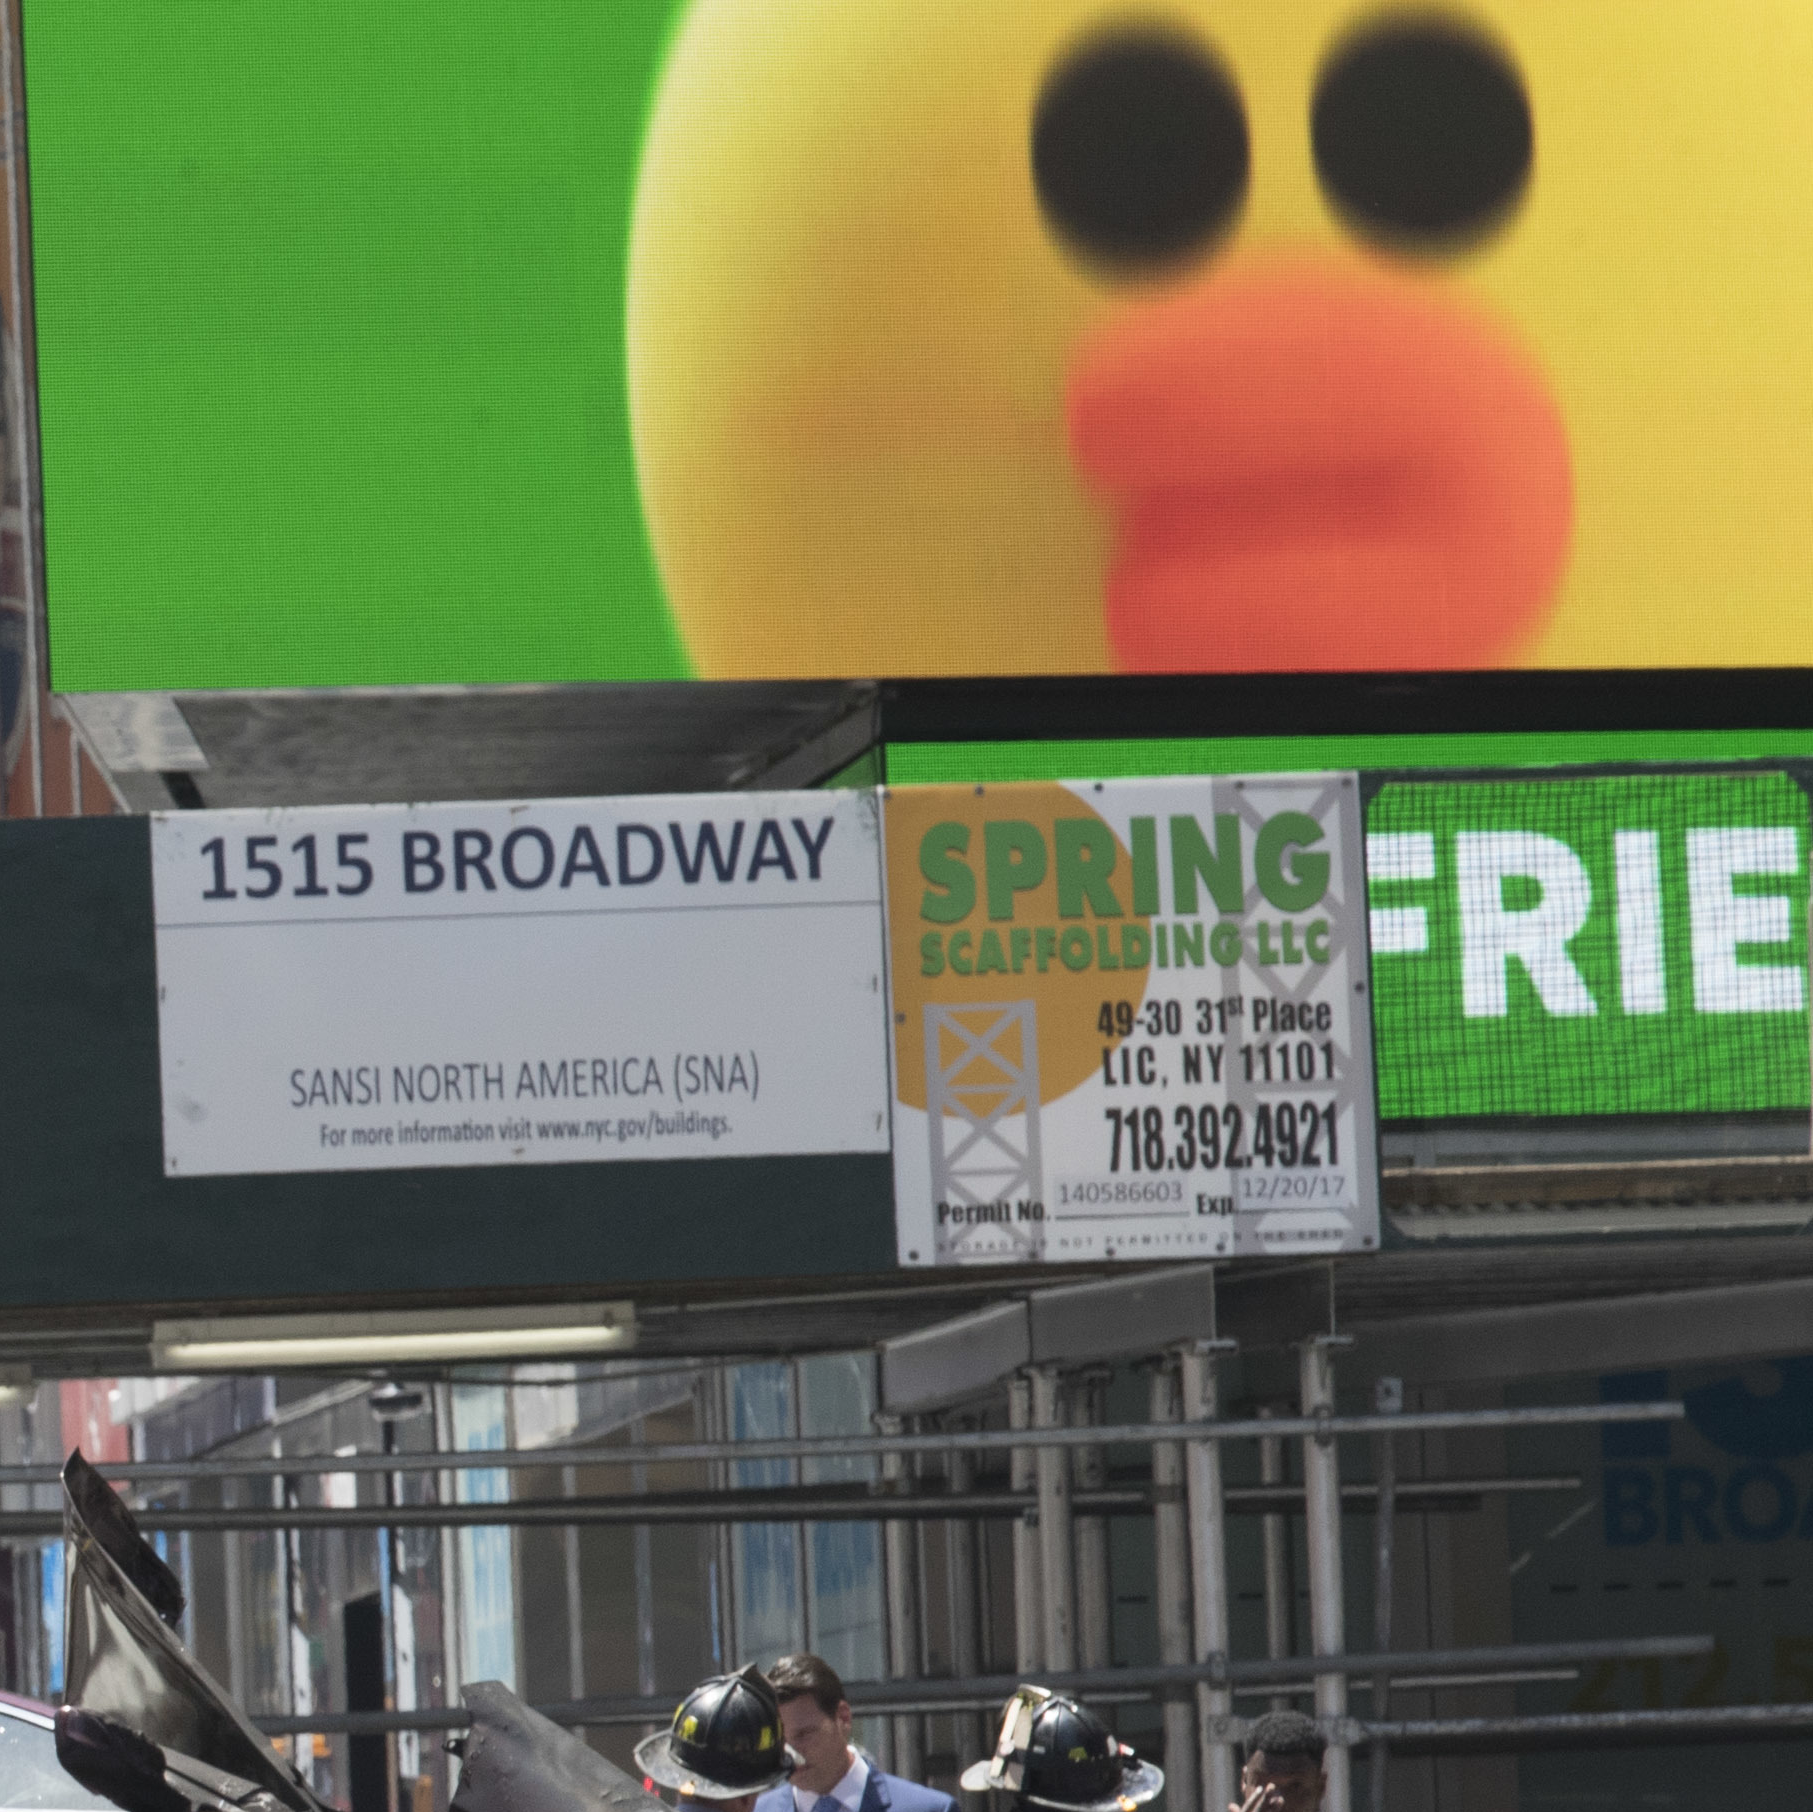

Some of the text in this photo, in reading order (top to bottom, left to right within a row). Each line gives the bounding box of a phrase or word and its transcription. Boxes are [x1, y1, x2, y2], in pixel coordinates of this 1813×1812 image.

[199, 816, 835, 901] 1515 BROADWAY
[919, 811, 1331, 923] SPRING
[919, 919, 1332, 977] SCAFFOLDING LLC
[1366, 826, 1805, 1018] FRIE
[1098, 995, 1332, 1038] 49-30 31st Place
[290, 1050, 760, 1108] SANSI NORTH AMERICA (SNA)
[1102, 1040, 1335, 1088] LIC, NY 11101
[320, 1123, 347, 1147] For
[351, 1123, 393, 1146] more
[398, 1118, 494, 1143] information
[498, 1115, 532, 1140] visit
[1105, 1100, 1338, 1173] 718.392.4921
[938, 1199, 1011, 1225] Permit
[1018, 1199, 1051, 1221] No.
[1059, 1176, 1347, 1204] 140586603 12/20/17
[1604, 1455, 1813, 1548] BRO
